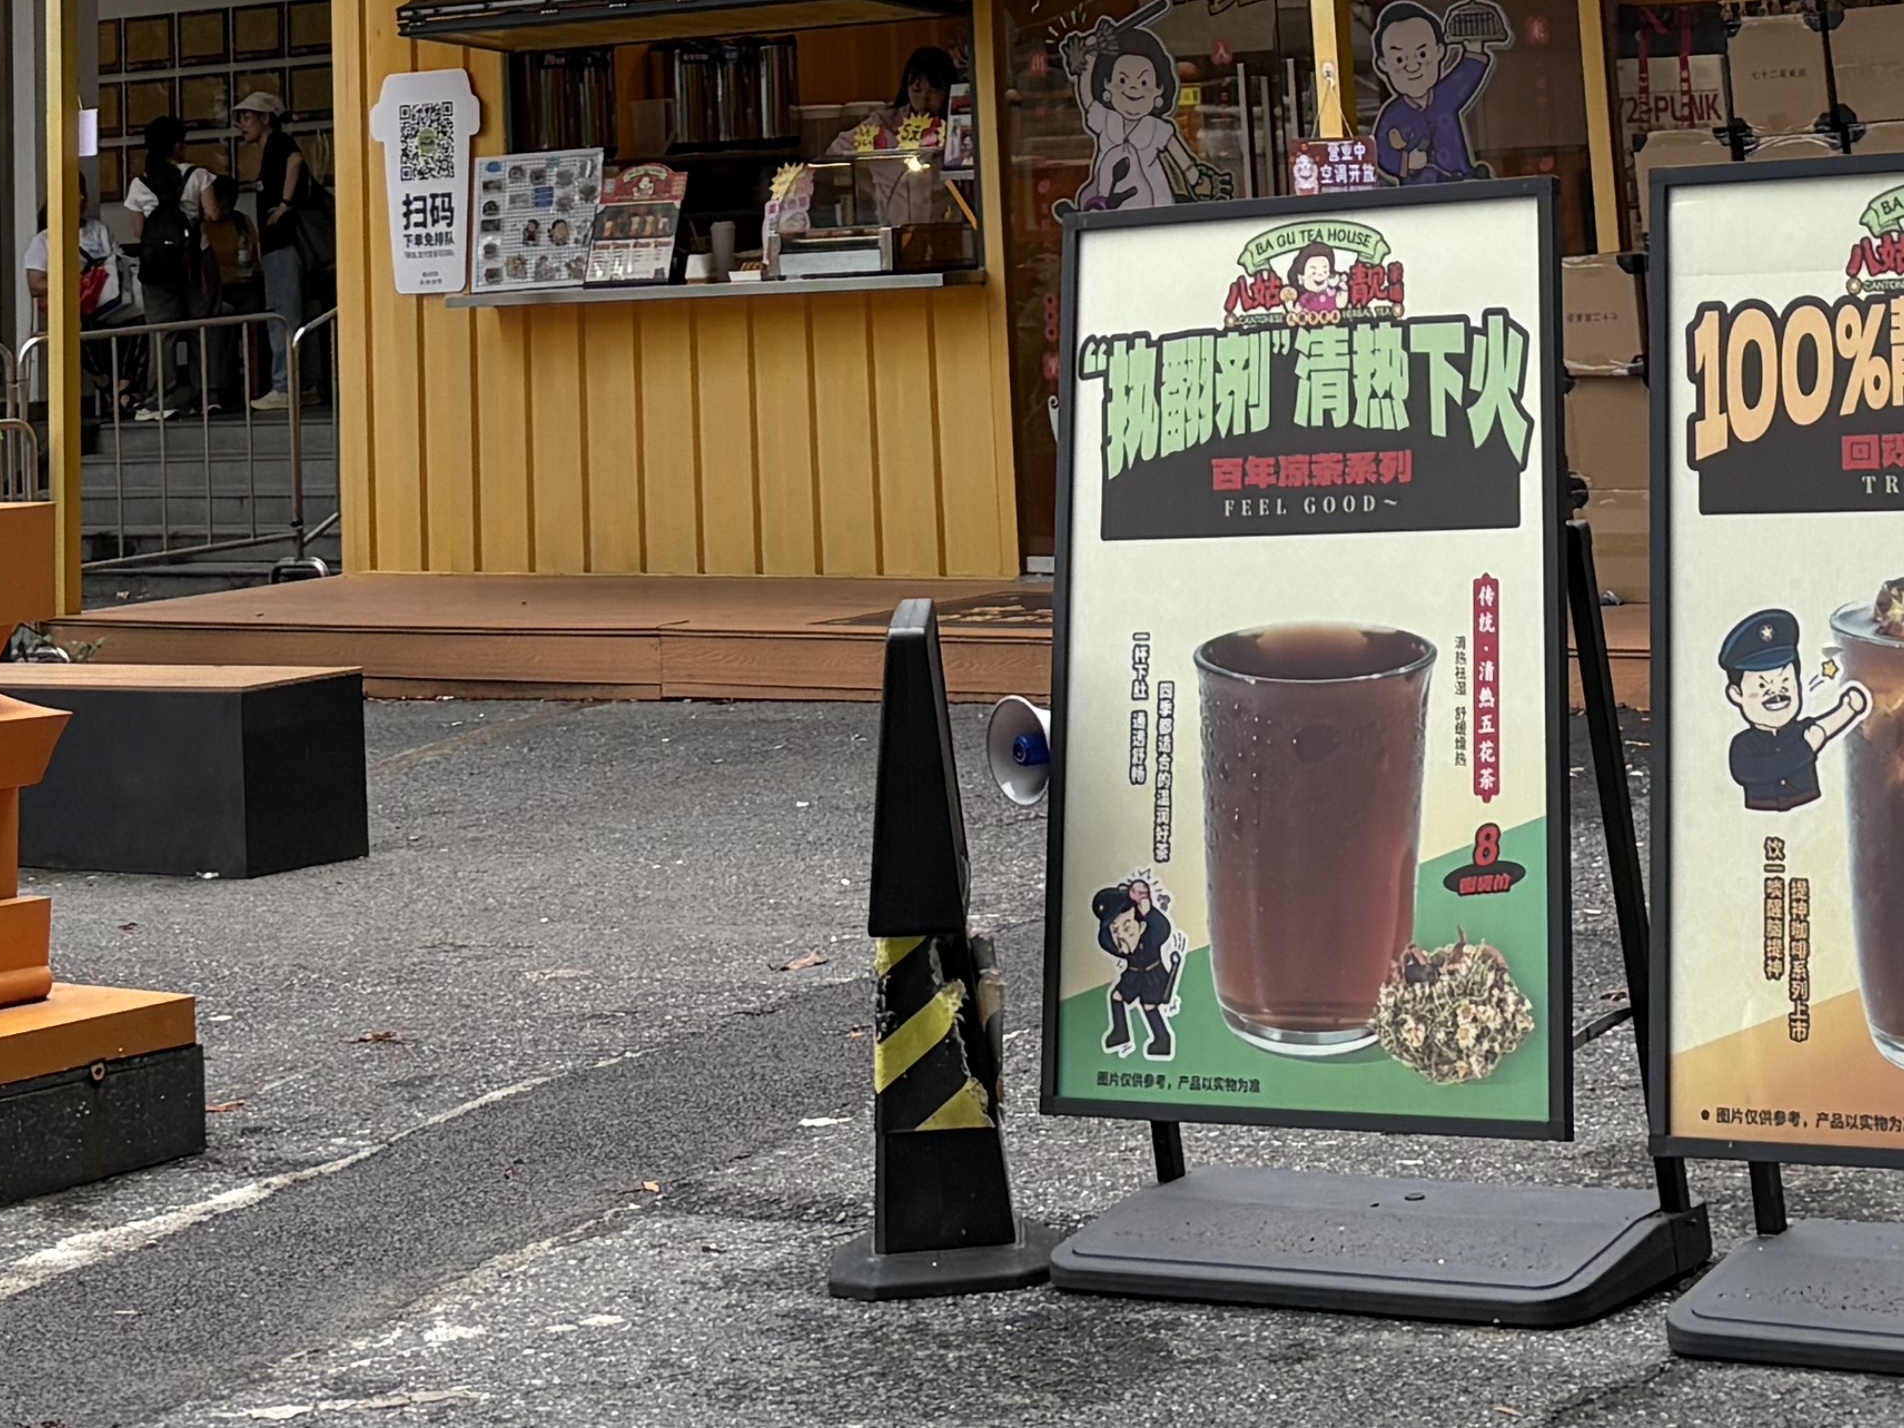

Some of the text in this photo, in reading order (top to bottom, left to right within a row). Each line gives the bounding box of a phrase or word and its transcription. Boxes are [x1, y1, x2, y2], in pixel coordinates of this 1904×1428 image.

[1327, 144, 1366, 162] 营业中
[1320, 162, 1376, 185] 空调开放
[402, 192, 454, 230] 扫码
[1211, 450, 1413, 491] 百年凉茶系列
[1224, 498, 1288, 517] FEEL
[1473, 823, 1502, 867] 8
[1789, 877, 1810, 1042] 提神咖啡系列上市
[1096, 1071, 1260, 1095] 图片仅供参考，产品以实物为准
